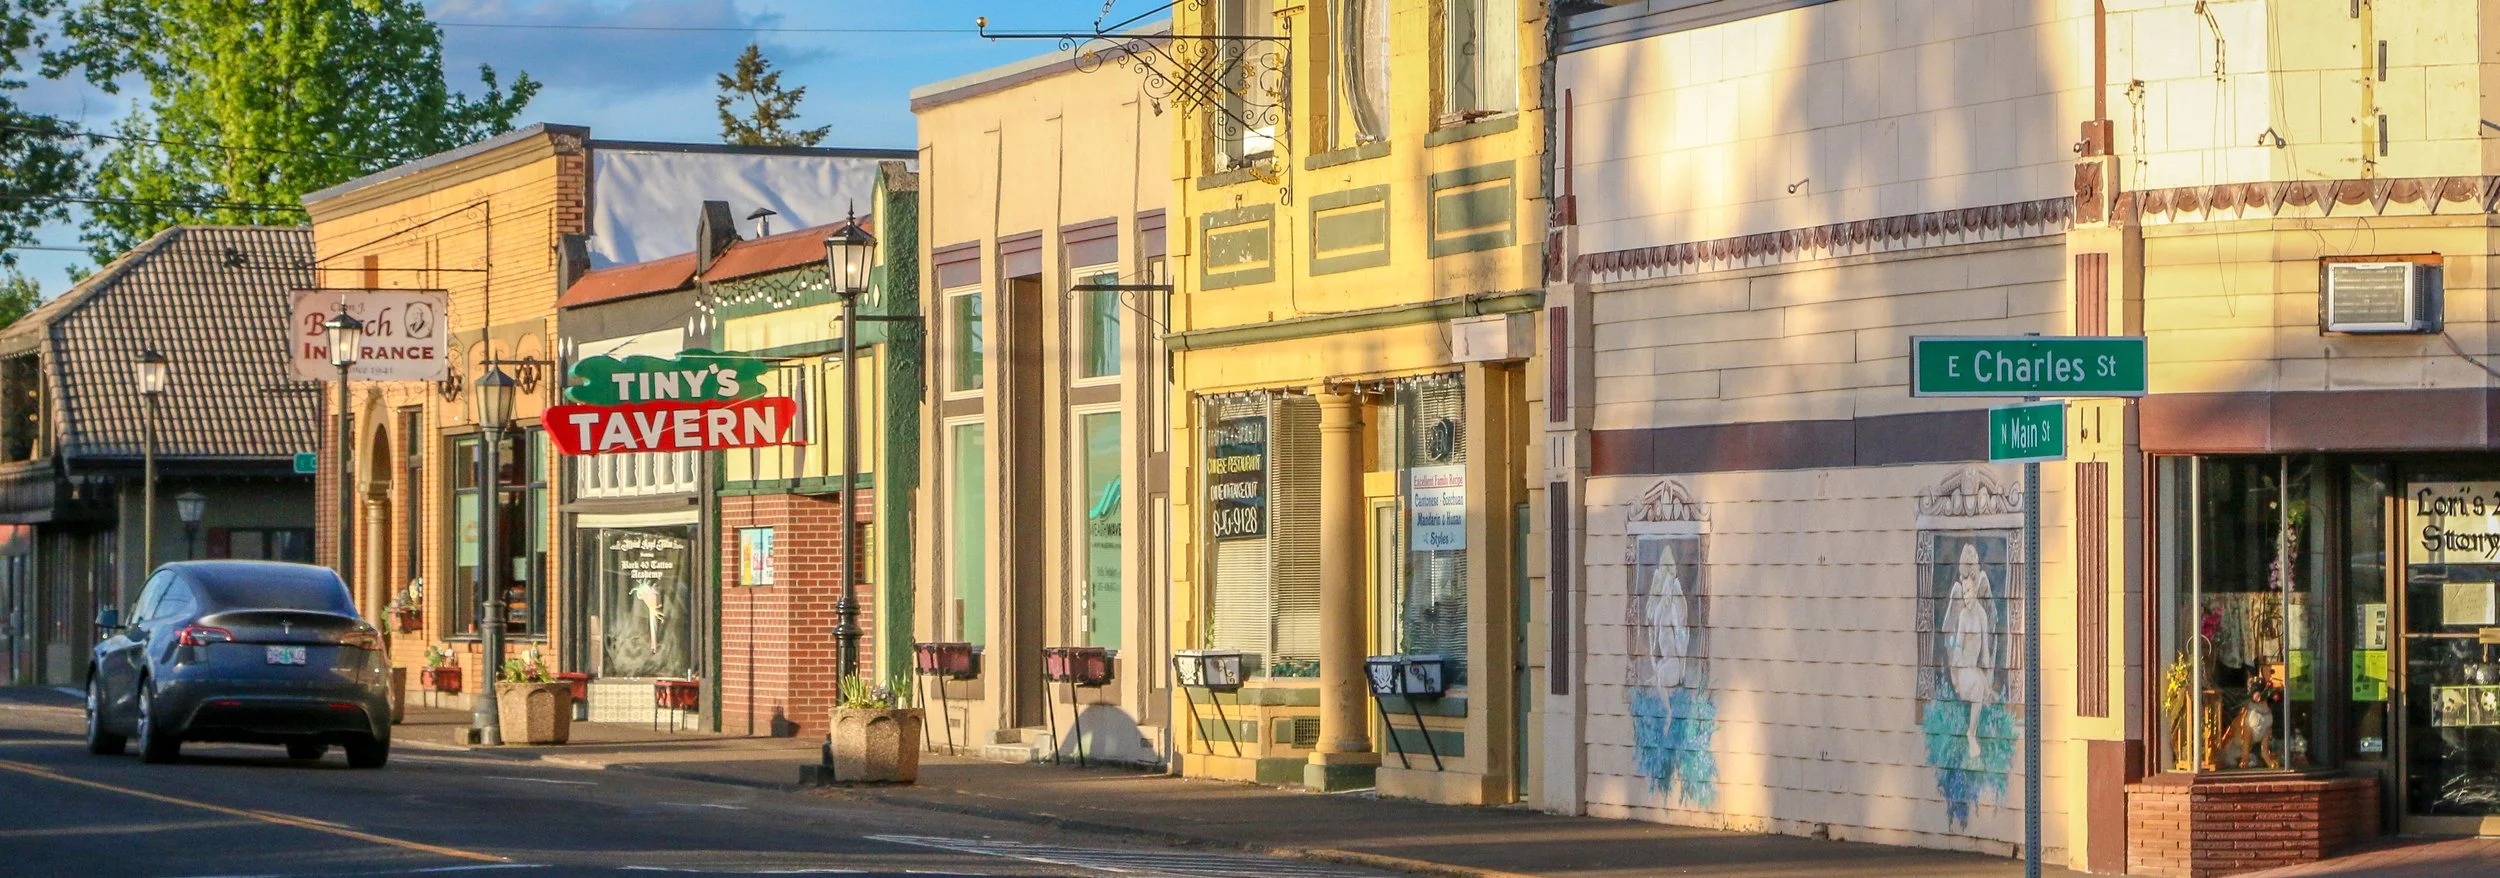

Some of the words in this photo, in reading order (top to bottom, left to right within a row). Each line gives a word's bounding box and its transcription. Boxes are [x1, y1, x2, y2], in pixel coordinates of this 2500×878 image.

[304, 307, 393, 336] Bch
[304, 343, 434, 359] INRANCE
[1948, 355, 1961, 377] E
[1974, 350, 2086, 382] Charles
[2097, 354, 2116, 377] St
[611, 363, 740, 401] TINY'S
[568, 406, 777, 451] TAVERN
[2001, 423, 2007, 445] N
[2011, 417, 2038, 449] Main
[2041, 419, 2050, 442] St
[1414, 493, 1439, 507] Cantonese
[2416, 486, 2486, 517] Lori's
[1417, 512, 1441, 526] Mandarin
[1446, 511, 1461, 525] Hunan
[1430, 531, 1449, 547] Styles
[621, 561, 639, 570] Back
[640, 561, 650, 569] 40
[650, 560, 673, 569] Tattoo
[631, 569, 663, 580] Academy
